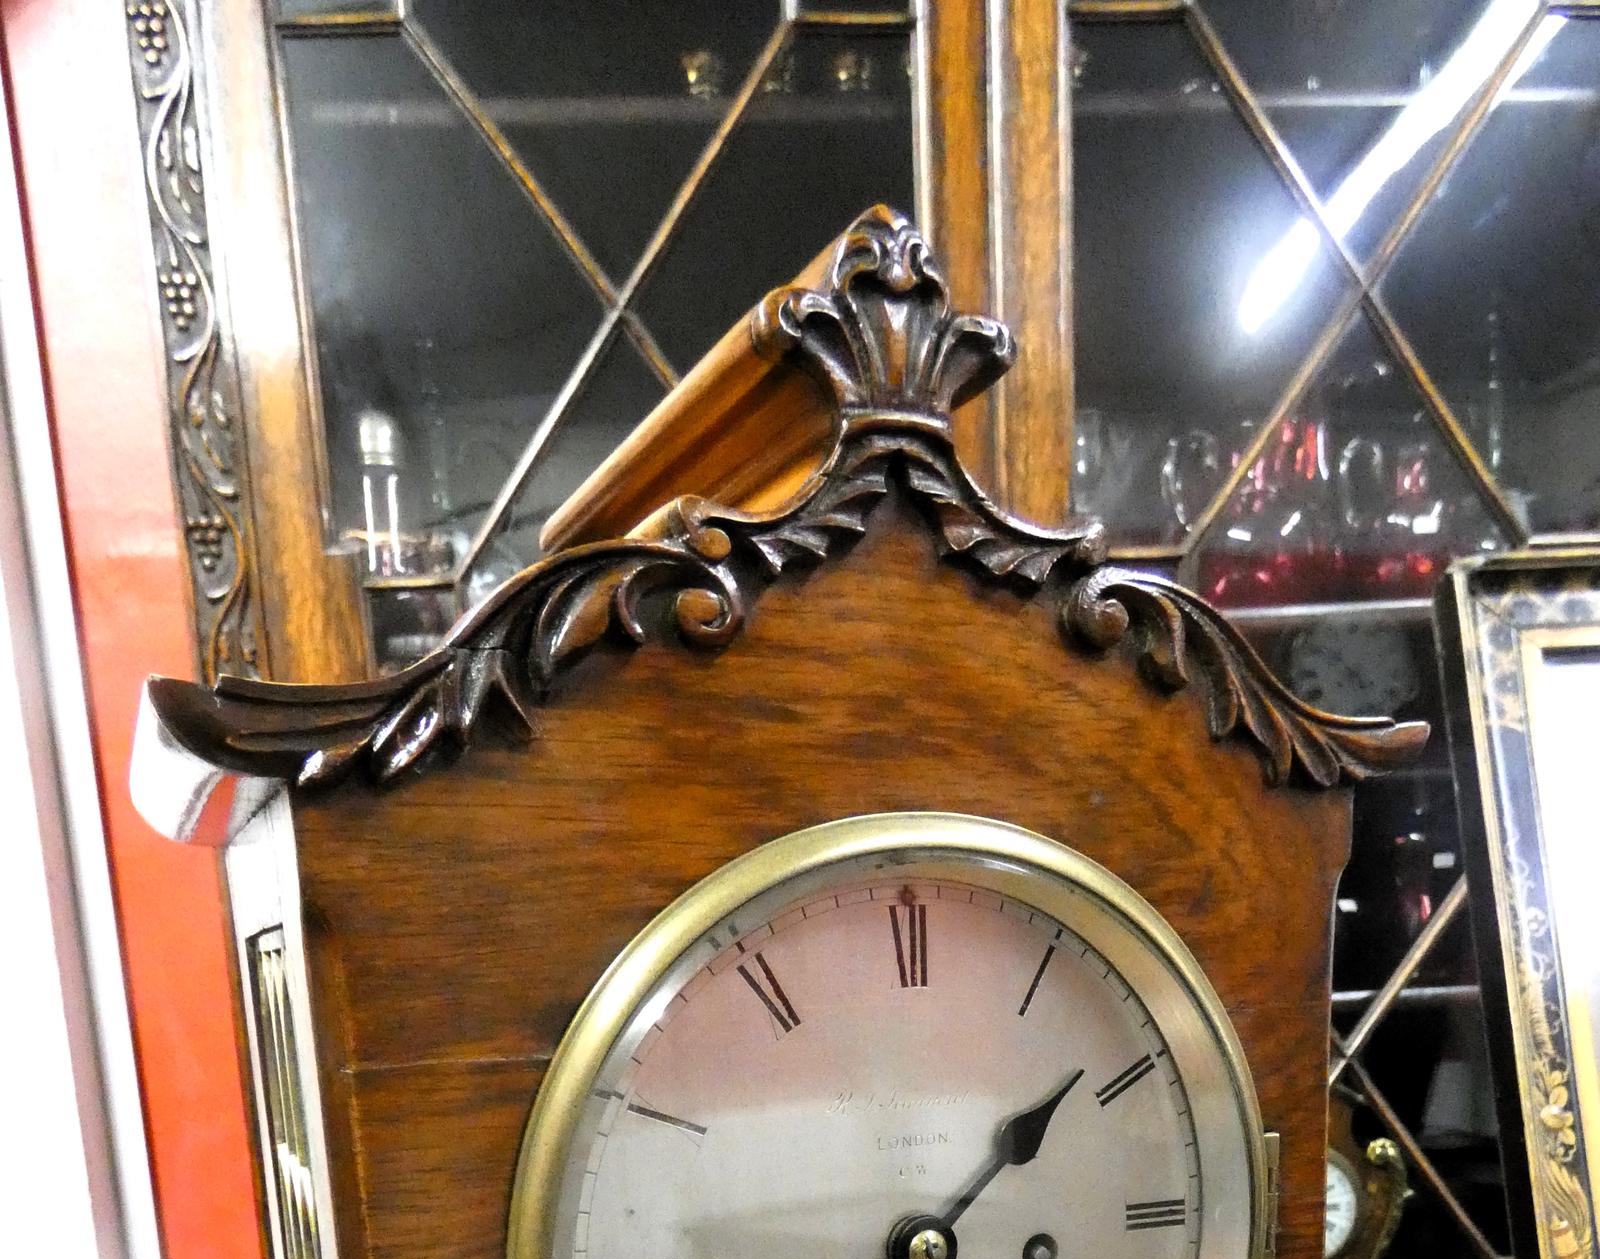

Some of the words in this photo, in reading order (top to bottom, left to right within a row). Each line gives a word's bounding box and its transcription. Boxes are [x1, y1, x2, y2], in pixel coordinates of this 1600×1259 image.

[888, 903, 928, 989] XII
[736, 951, 801, 1041] XI
[1017, 943, 1056, 1017] I
[1095, 1053, 1156, 1107] II
[626, 1090, 708, 1149] X
[1124, 1197, 1186, 1233] III
